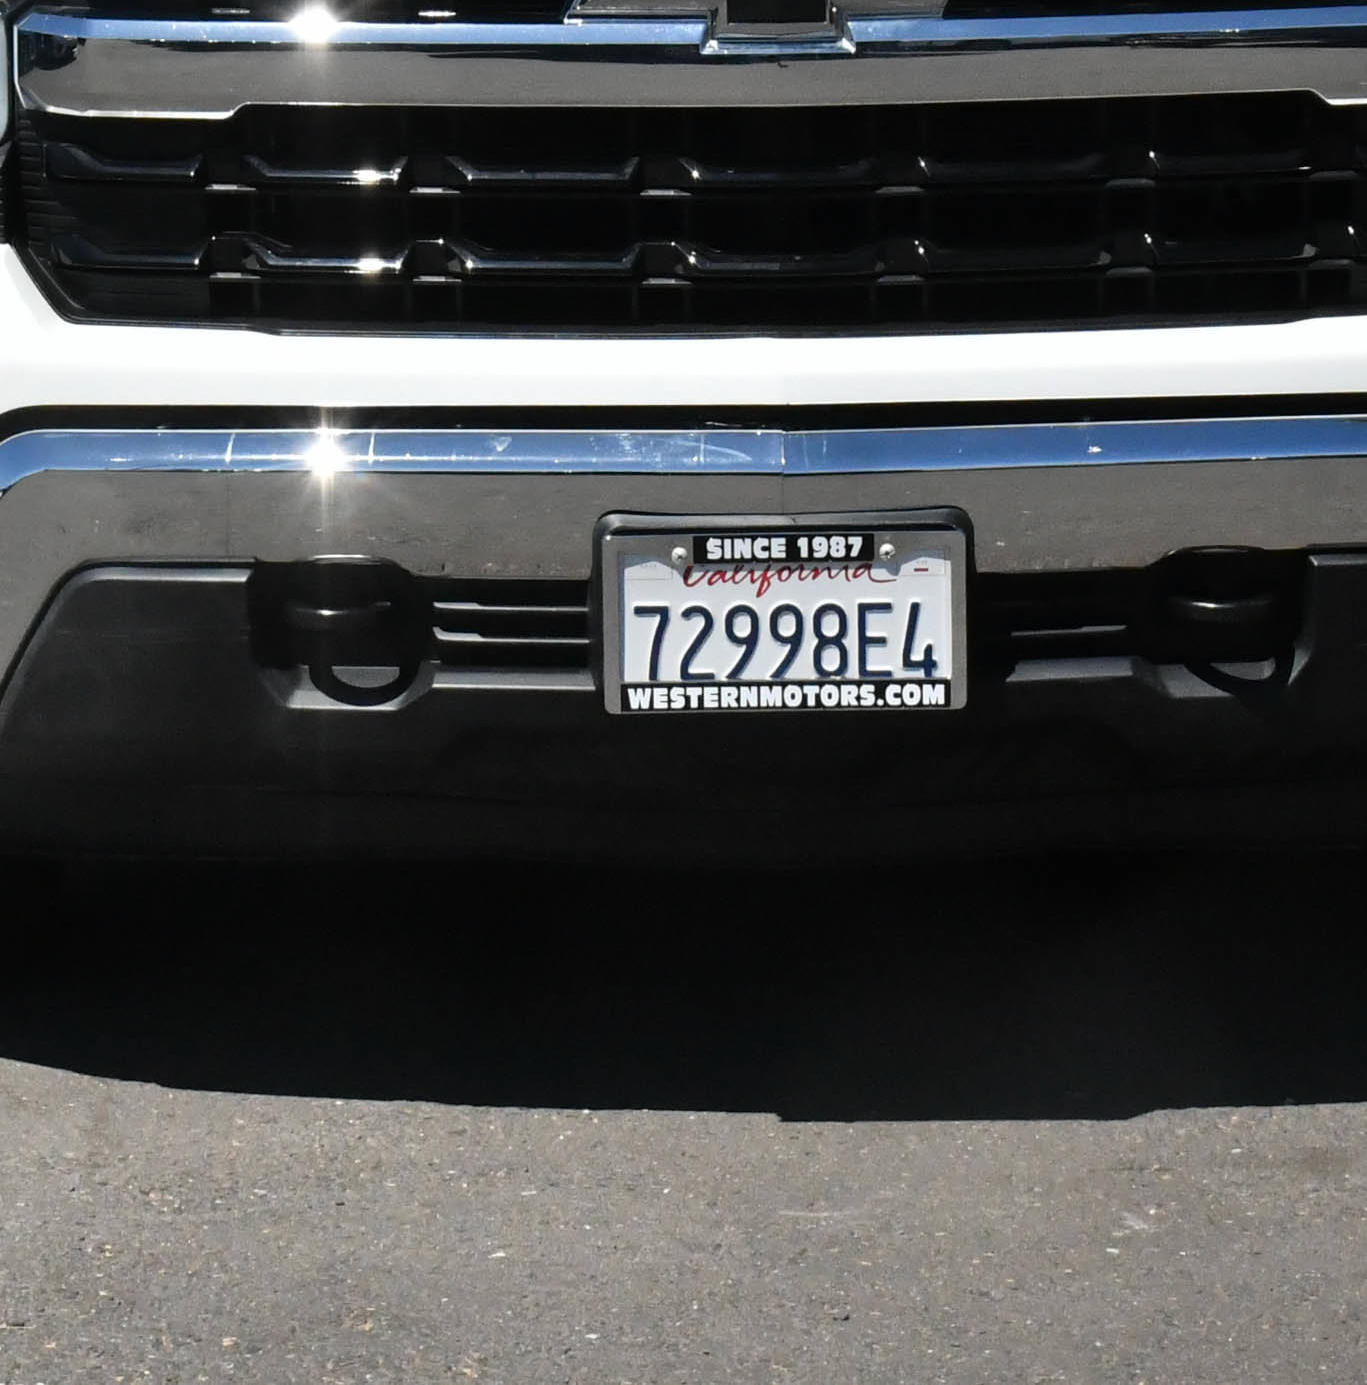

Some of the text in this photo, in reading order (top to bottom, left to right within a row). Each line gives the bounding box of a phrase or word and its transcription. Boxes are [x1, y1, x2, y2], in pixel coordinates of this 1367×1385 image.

[705, 535, 863, 560] SINCE 1987
[681, 562, 898, 598] California
[633, 601, 938, 681] 72998E4
[627, 683, 946, 711] WESTERNMOTORS.COM
